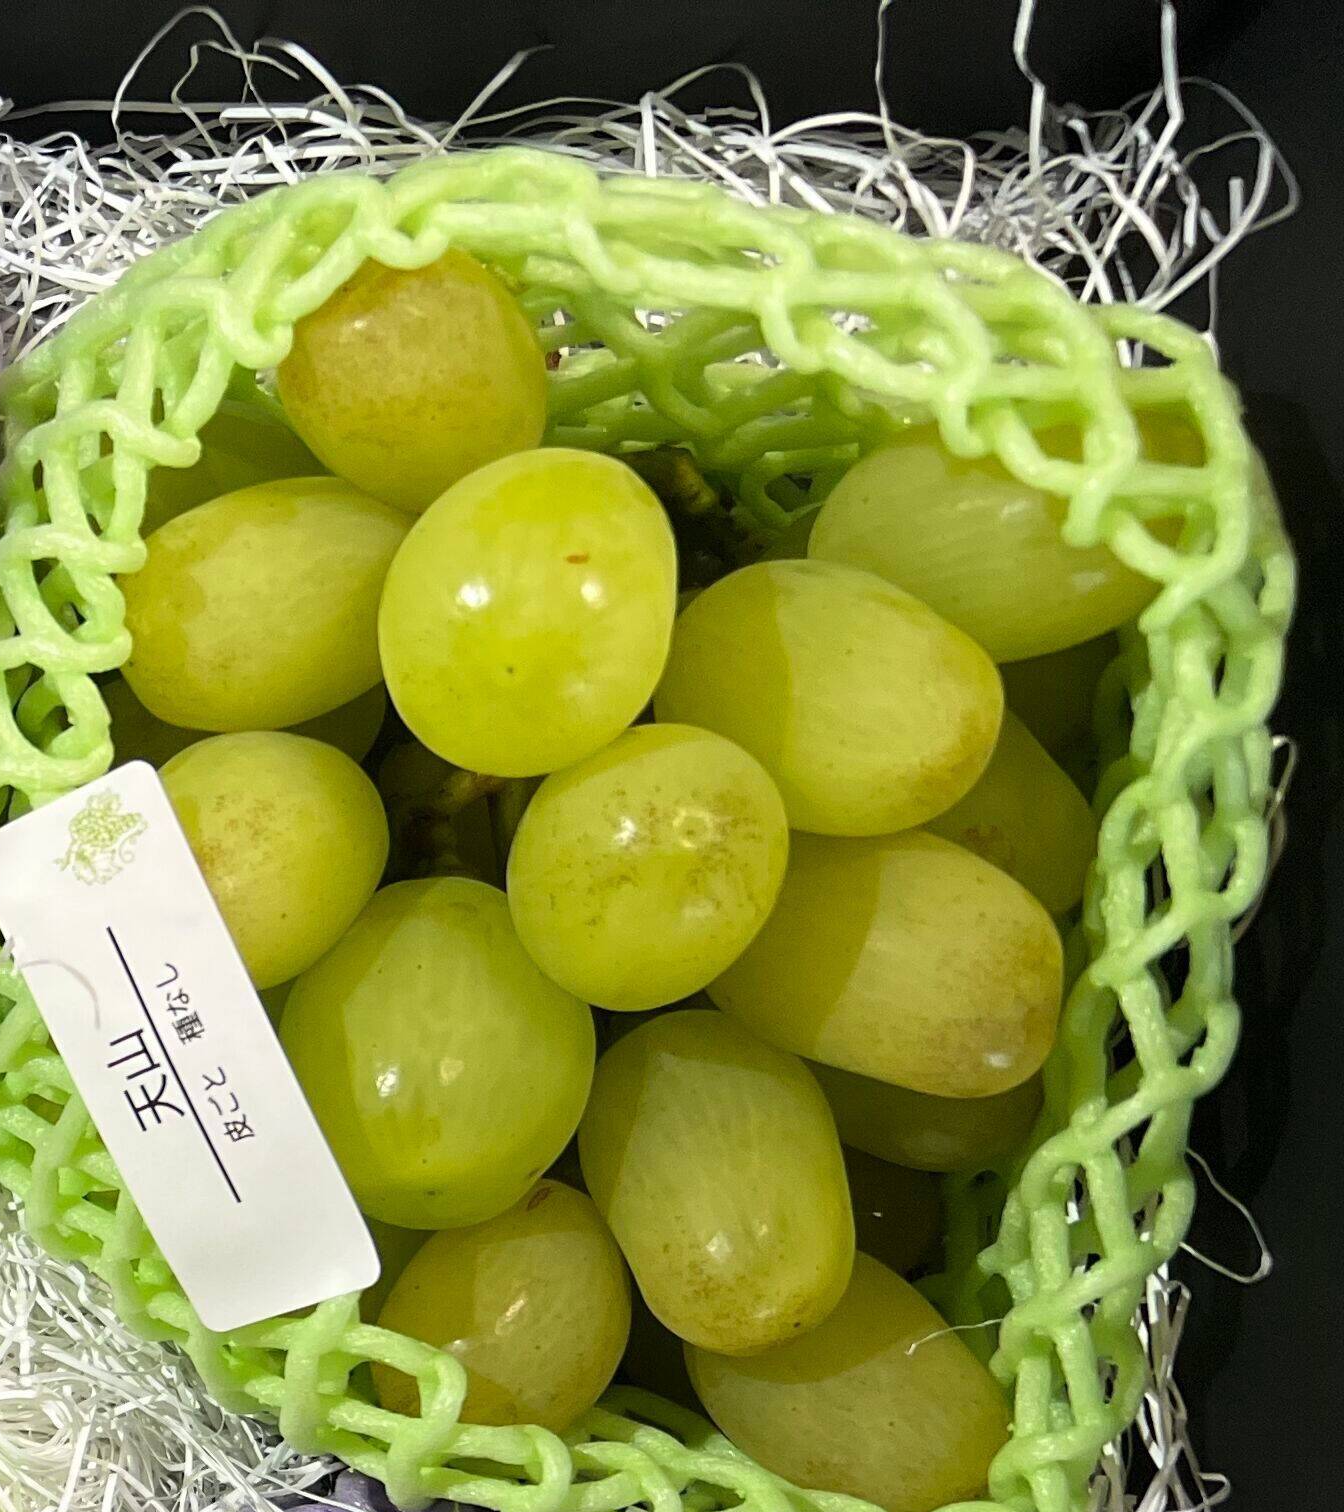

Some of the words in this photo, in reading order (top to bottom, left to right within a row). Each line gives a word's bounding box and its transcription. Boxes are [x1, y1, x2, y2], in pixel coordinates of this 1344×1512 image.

[155, 962, 206, 1046] 種なし
[107, 1028, 186, 1132] 天山
[201, 1066, 256, 1143] 皮ごと
